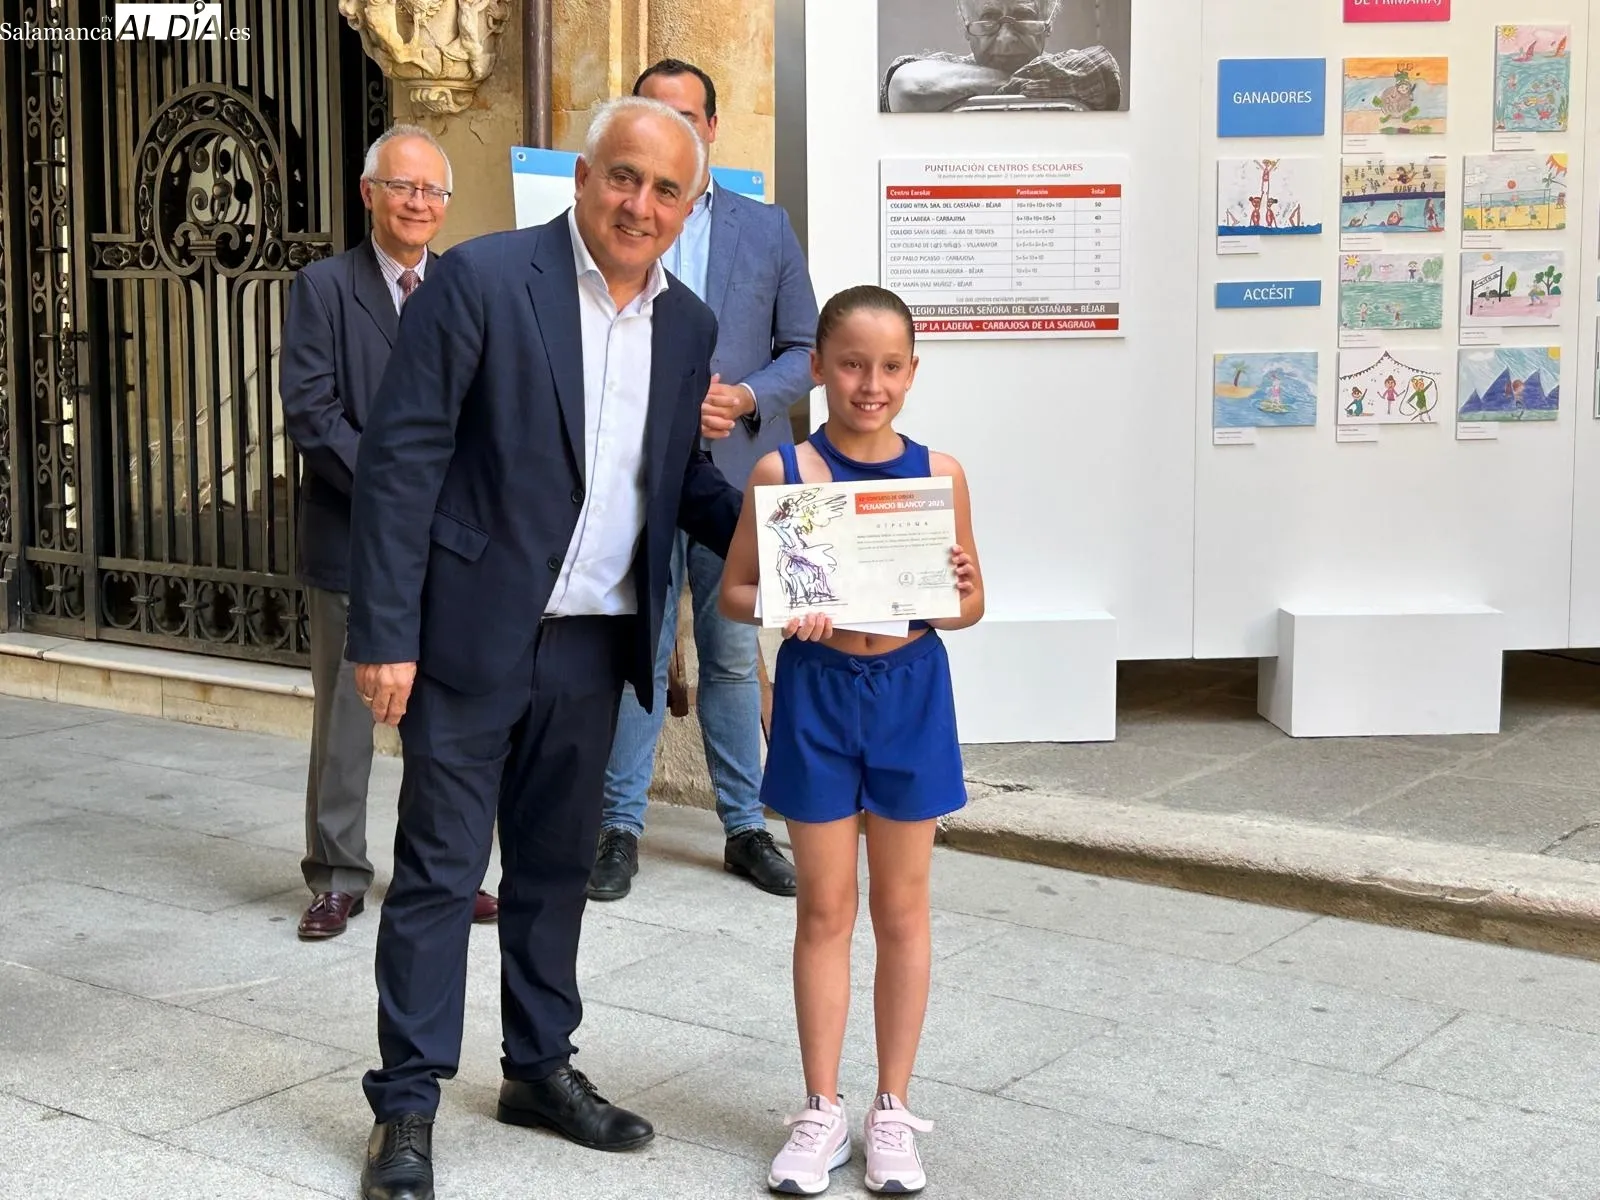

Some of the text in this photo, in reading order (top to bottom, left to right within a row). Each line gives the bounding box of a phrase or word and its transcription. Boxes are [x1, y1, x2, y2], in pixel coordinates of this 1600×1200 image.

[1232, 90, 1312, 104] GANADORES
[925, 162, 1084, 172] PUNTUACIÓN CENTROS ESCOLARES
[1243, 285, 1295, 301] ACCÉSIT
[908, 306, 935, 316] OLEGIO
[937, 306, 974, 315] NUESTRA
[976, 304, 1010, 315] SEÑORA
[1011, 305, 1026, 314] DEL
[1029, 303, 1072, 313] CASTAÑAR
[1080, 303, 1105, 313] BÉJAR
[914, 322, 929, 331] EIP
[929, 322, 940, 330] LA
[942, 321, 973, 330] LADERA
[982, 321, 1030, 330] CARBAJOSA
[1032, 321, 1042, 329] DE
[1044, 321, 1056, 329] LA
[1057, 320, 1096, 329] SAGRADA
